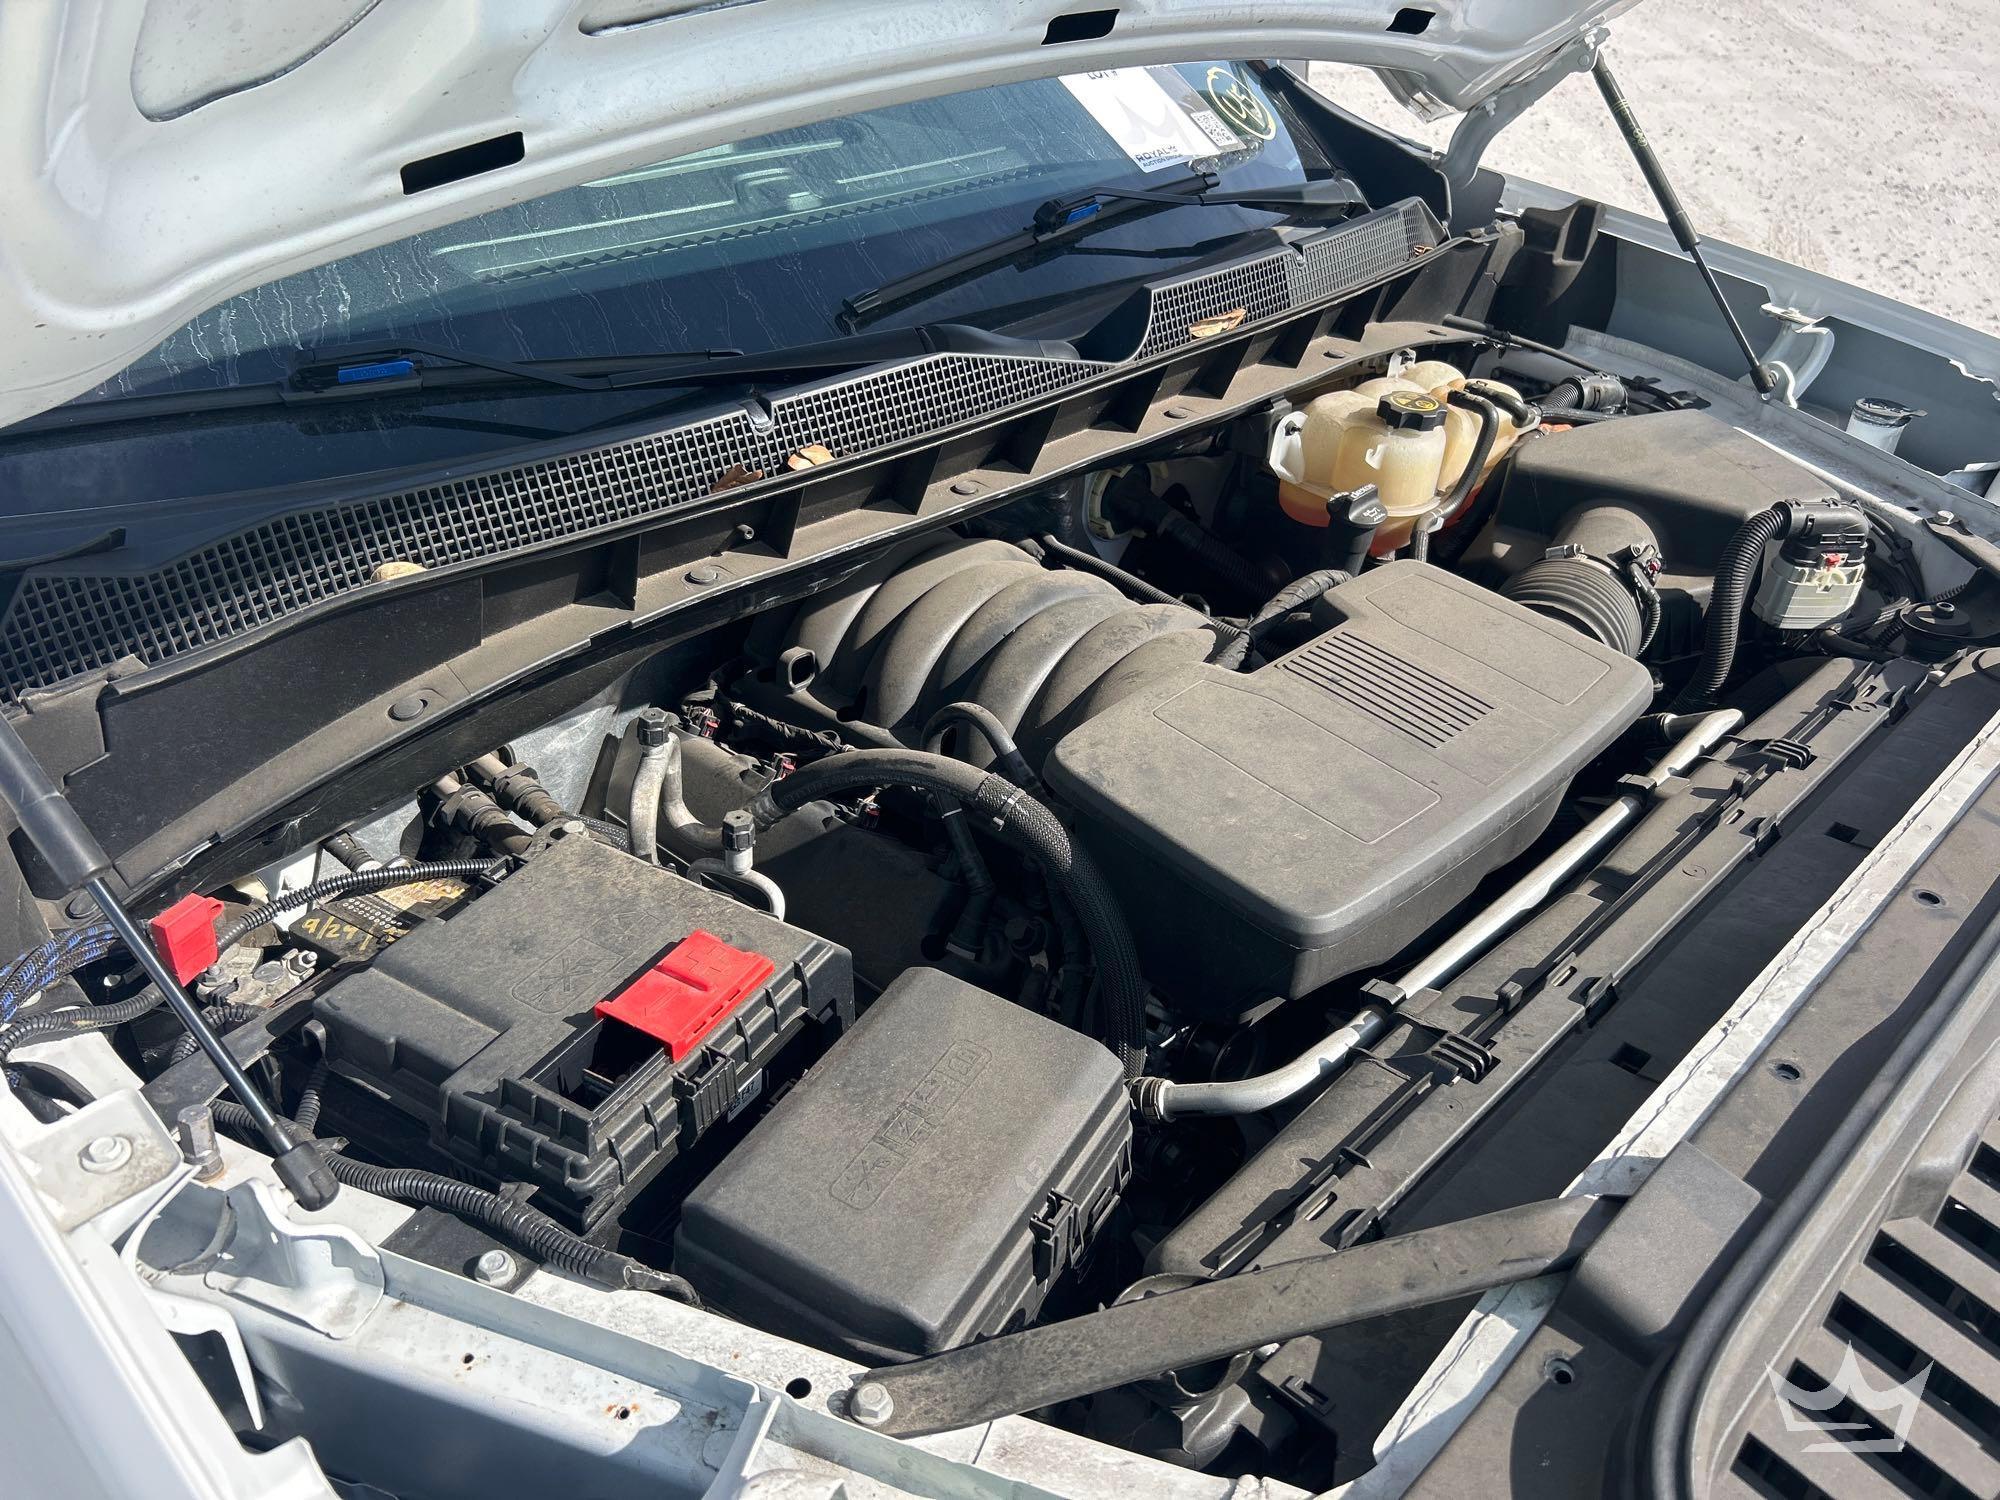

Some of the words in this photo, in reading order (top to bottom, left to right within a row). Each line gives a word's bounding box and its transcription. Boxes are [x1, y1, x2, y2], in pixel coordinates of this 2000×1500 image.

[1135, 147, 1170, 162] ROYAL
[1142, 157, 1166, 168] AUCTION
[1350, 482, 1376, 499] dexos
